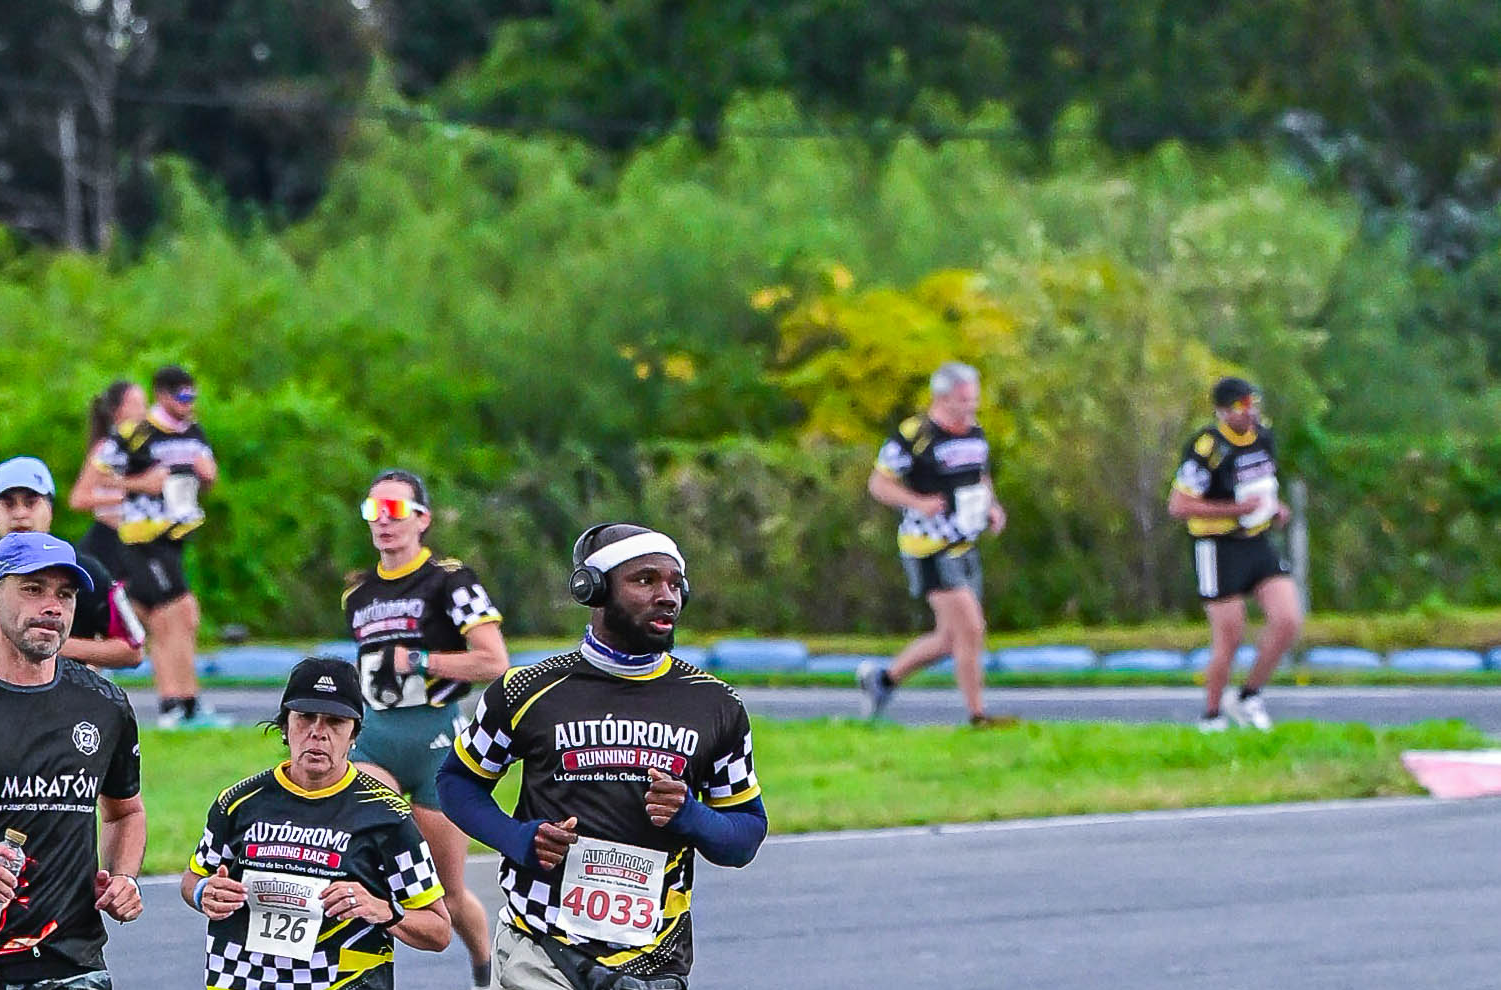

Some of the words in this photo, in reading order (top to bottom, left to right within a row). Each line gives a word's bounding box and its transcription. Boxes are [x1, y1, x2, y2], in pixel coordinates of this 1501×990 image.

[554, 713, 699, 757] AUTÓDROMO
[576, 749, 636, 767] RUNNING
[639, 751, 675, 771] RACE
[0, 768, 98, 798] MARATÓN
[563, 772, 592, 781] Carrera
[594, 772, 604, 781] de
[605, 772, 617, 780] los
[619, 772, 646, 781] Clubes
[243, 821, 352, 852] AUTÓDROMO
[256, 846, 301, 859] RUNNING
[300, 848, 331, 865] RACE
[266, 861, 274, 869] de
[285, 863, 306, 872] Clubes
[307, 865, 318, 875] del
[581, 848, 654, 875] AUTÓDROMO
[562, 886, 654, 929] 4033
[259, 911, 309, 943] 126
